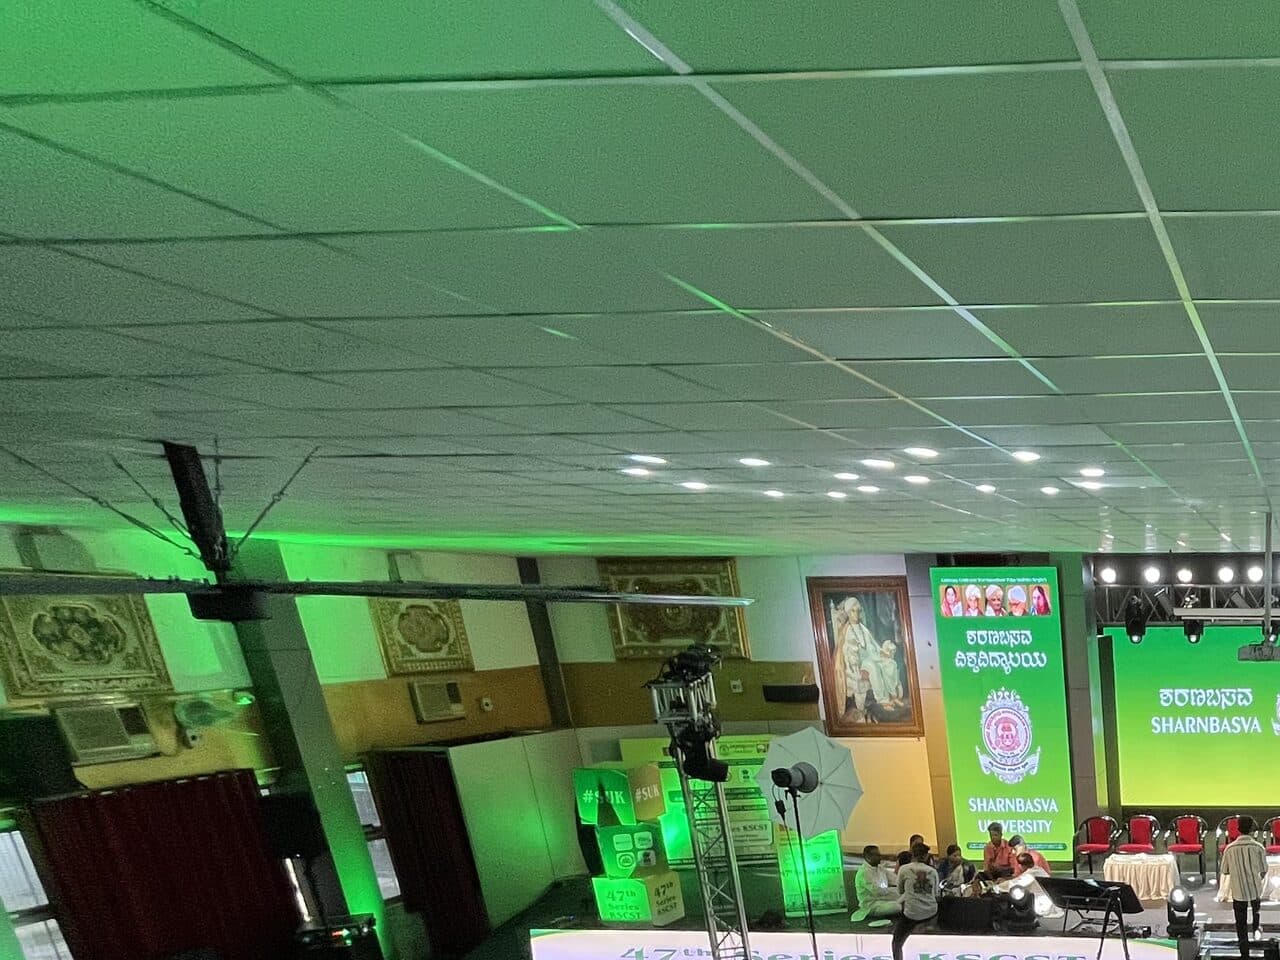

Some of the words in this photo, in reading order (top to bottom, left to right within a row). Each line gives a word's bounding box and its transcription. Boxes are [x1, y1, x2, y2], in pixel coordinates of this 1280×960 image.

[1151, 716, 1262, 734] SHARNBASVA
[968, 797, 1058, 813] SHARNBASVA
[607, 890, 636, 902] 47th
[653, 881, 674, 897] 47th
[607, 903, 640, 911] Series
